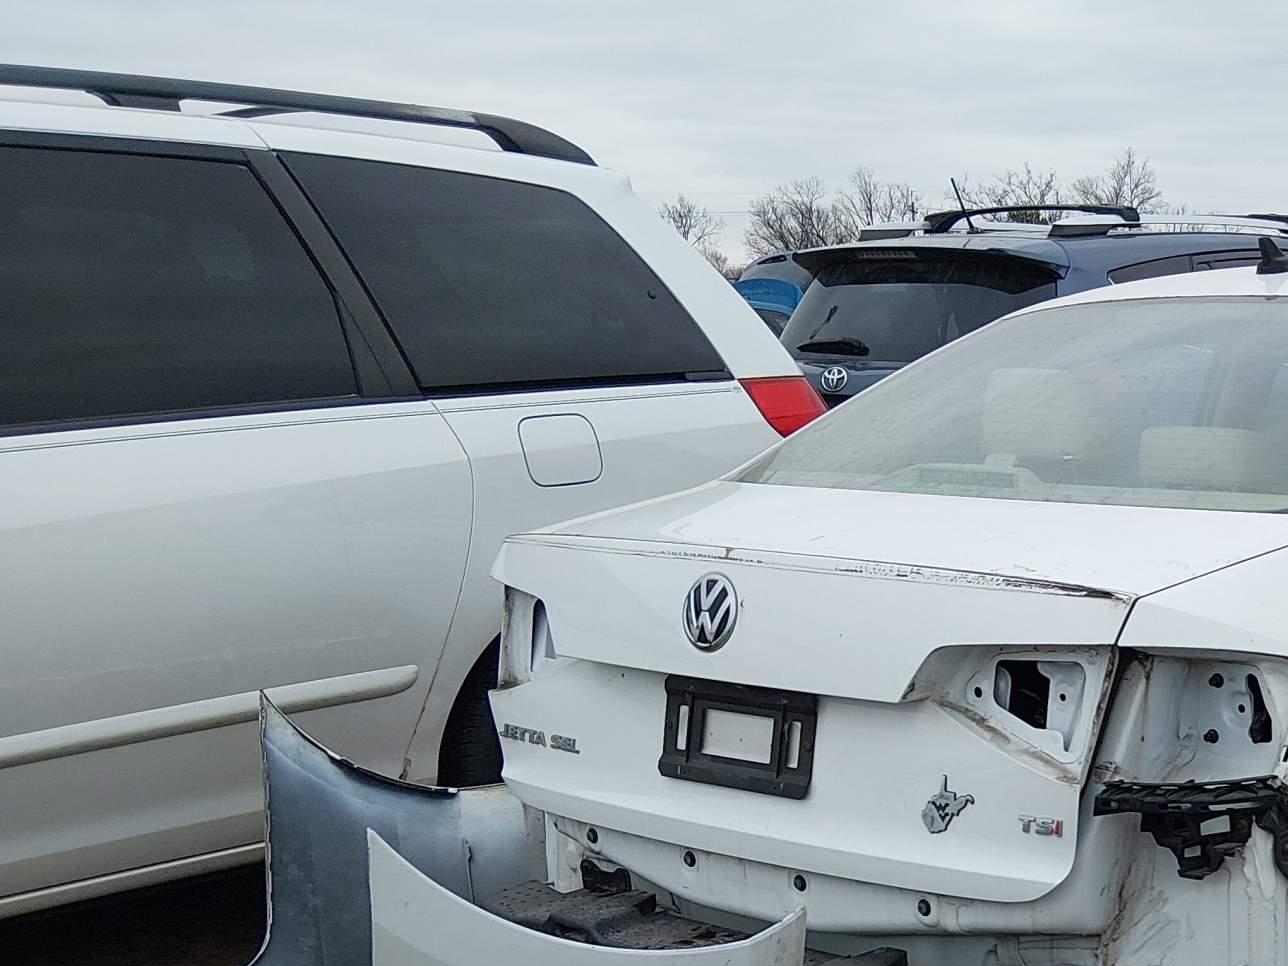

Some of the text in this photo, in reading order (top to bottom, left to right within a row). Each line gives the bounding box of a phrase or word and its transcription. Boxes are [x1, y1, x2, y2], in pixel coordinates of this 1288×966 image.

[499, 723, 580, 754] JETTA SEL
[1018, 814, 1064, 838] TSI
